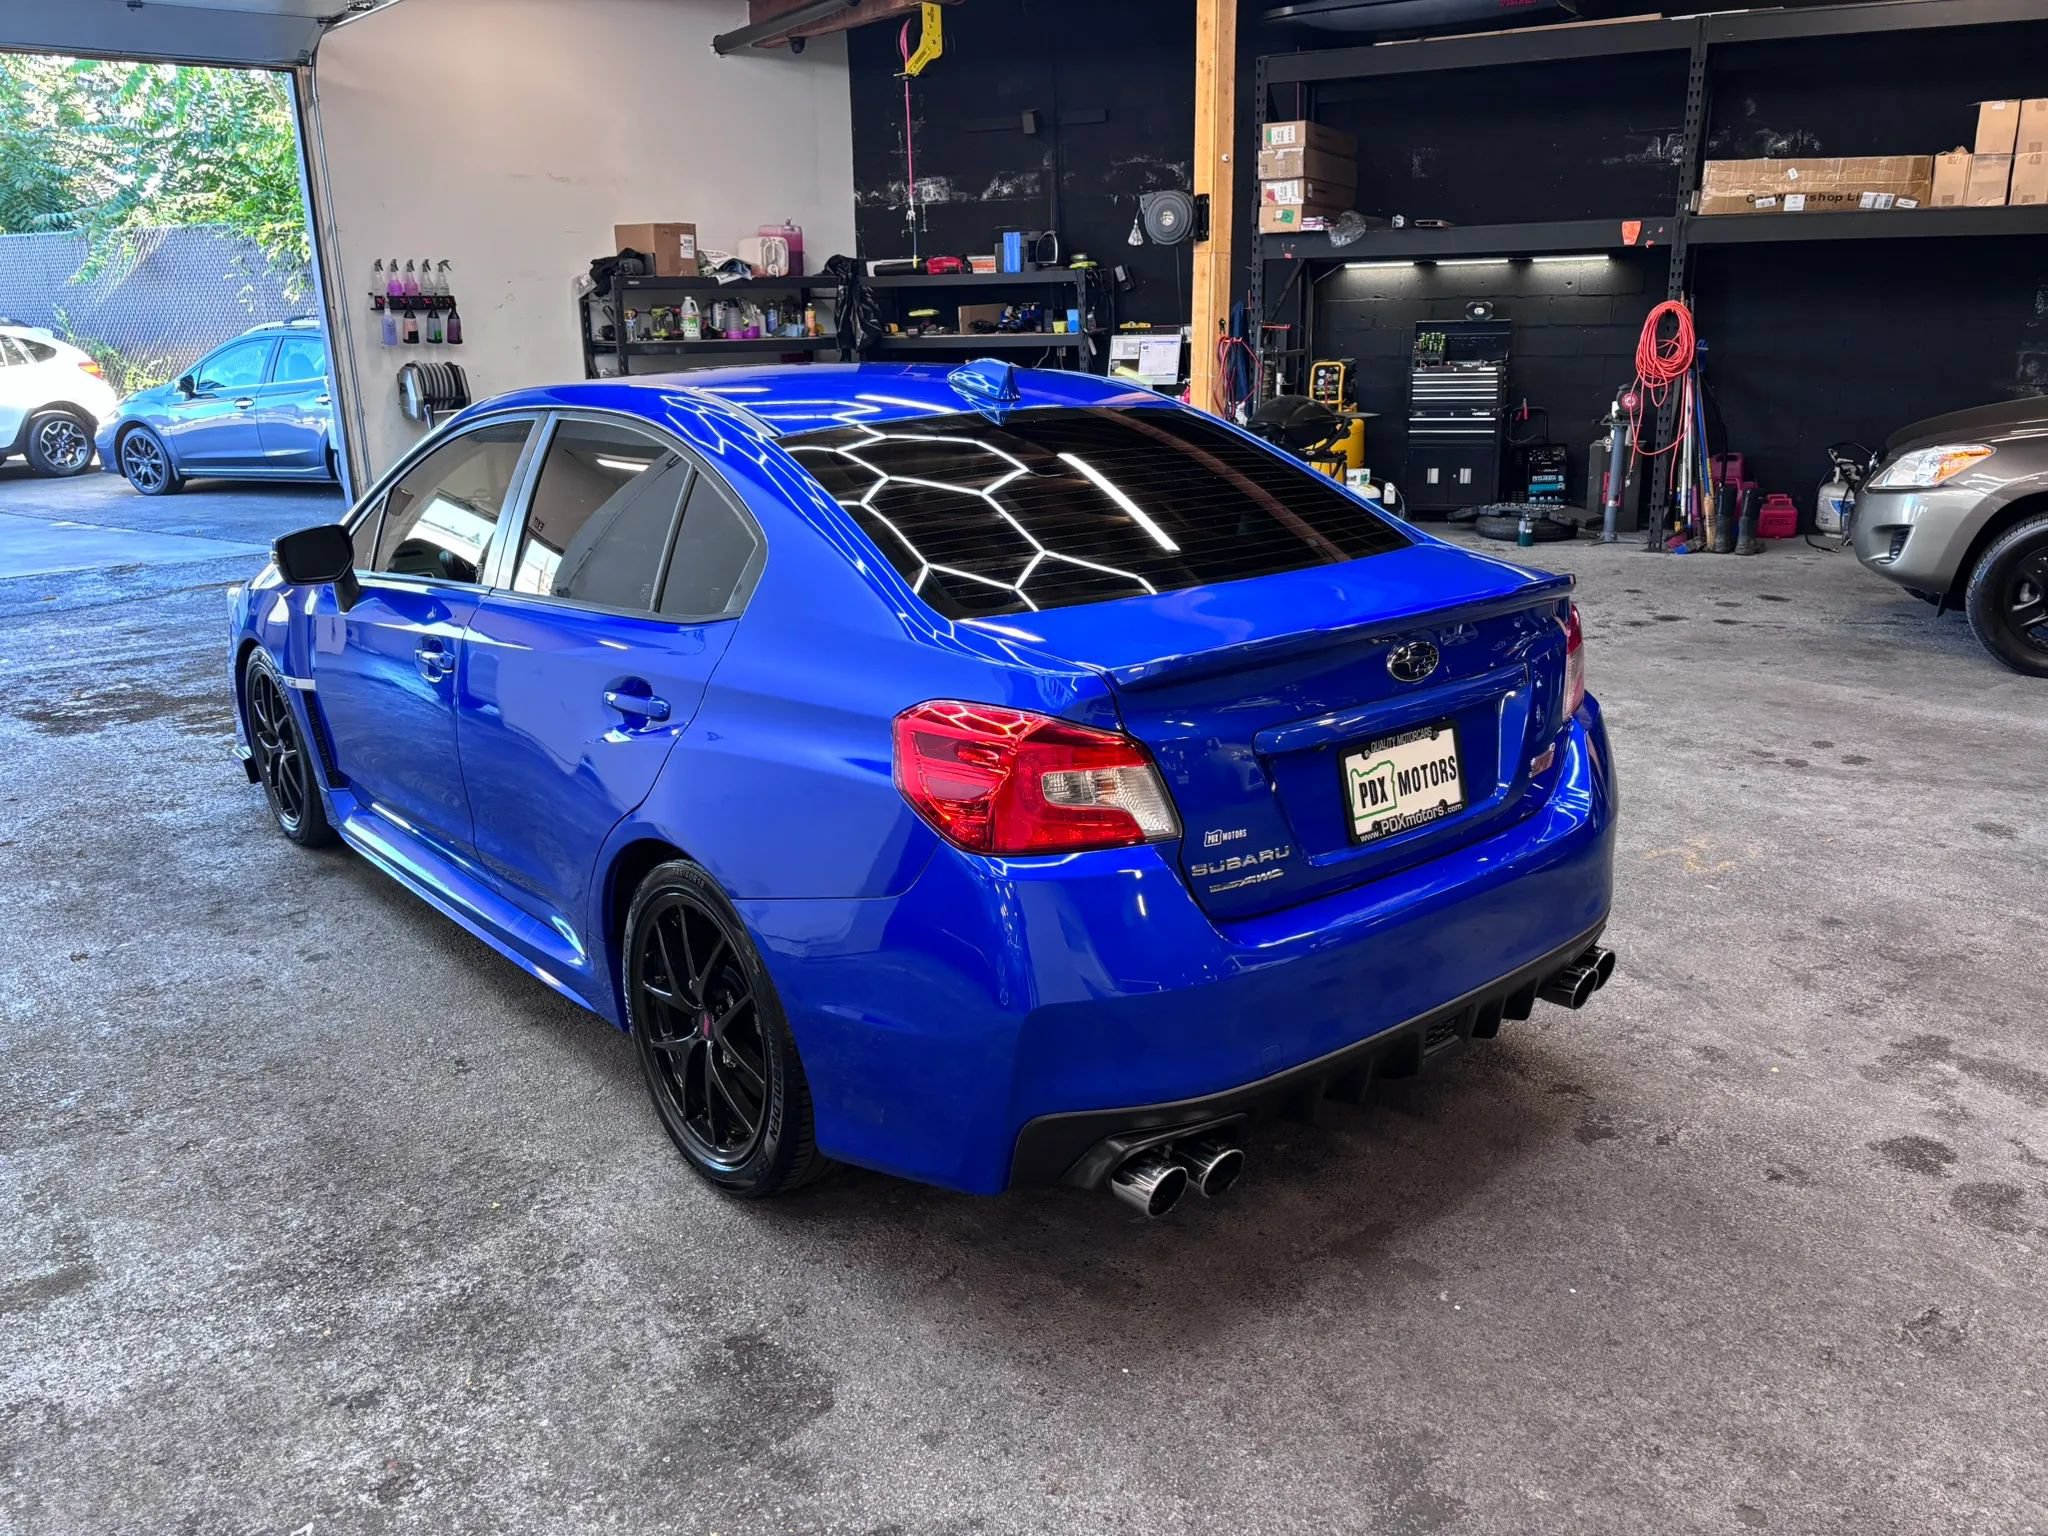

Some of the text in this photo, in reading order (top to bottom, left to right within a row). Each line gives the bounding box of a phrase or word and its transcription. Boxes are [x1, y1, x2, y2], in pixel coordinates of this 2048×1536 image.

[1371, 727, 1432, 753] QUALITY MOTORCARS
[1359, 755, 1457, 809] PDX MOTORS
[1207, 829, 1247, 844] PDX MOTORS
[1360, 803, 1463, 843] www.PDXmotors.com
[1191, 845, 1290, 877] SUBARU
